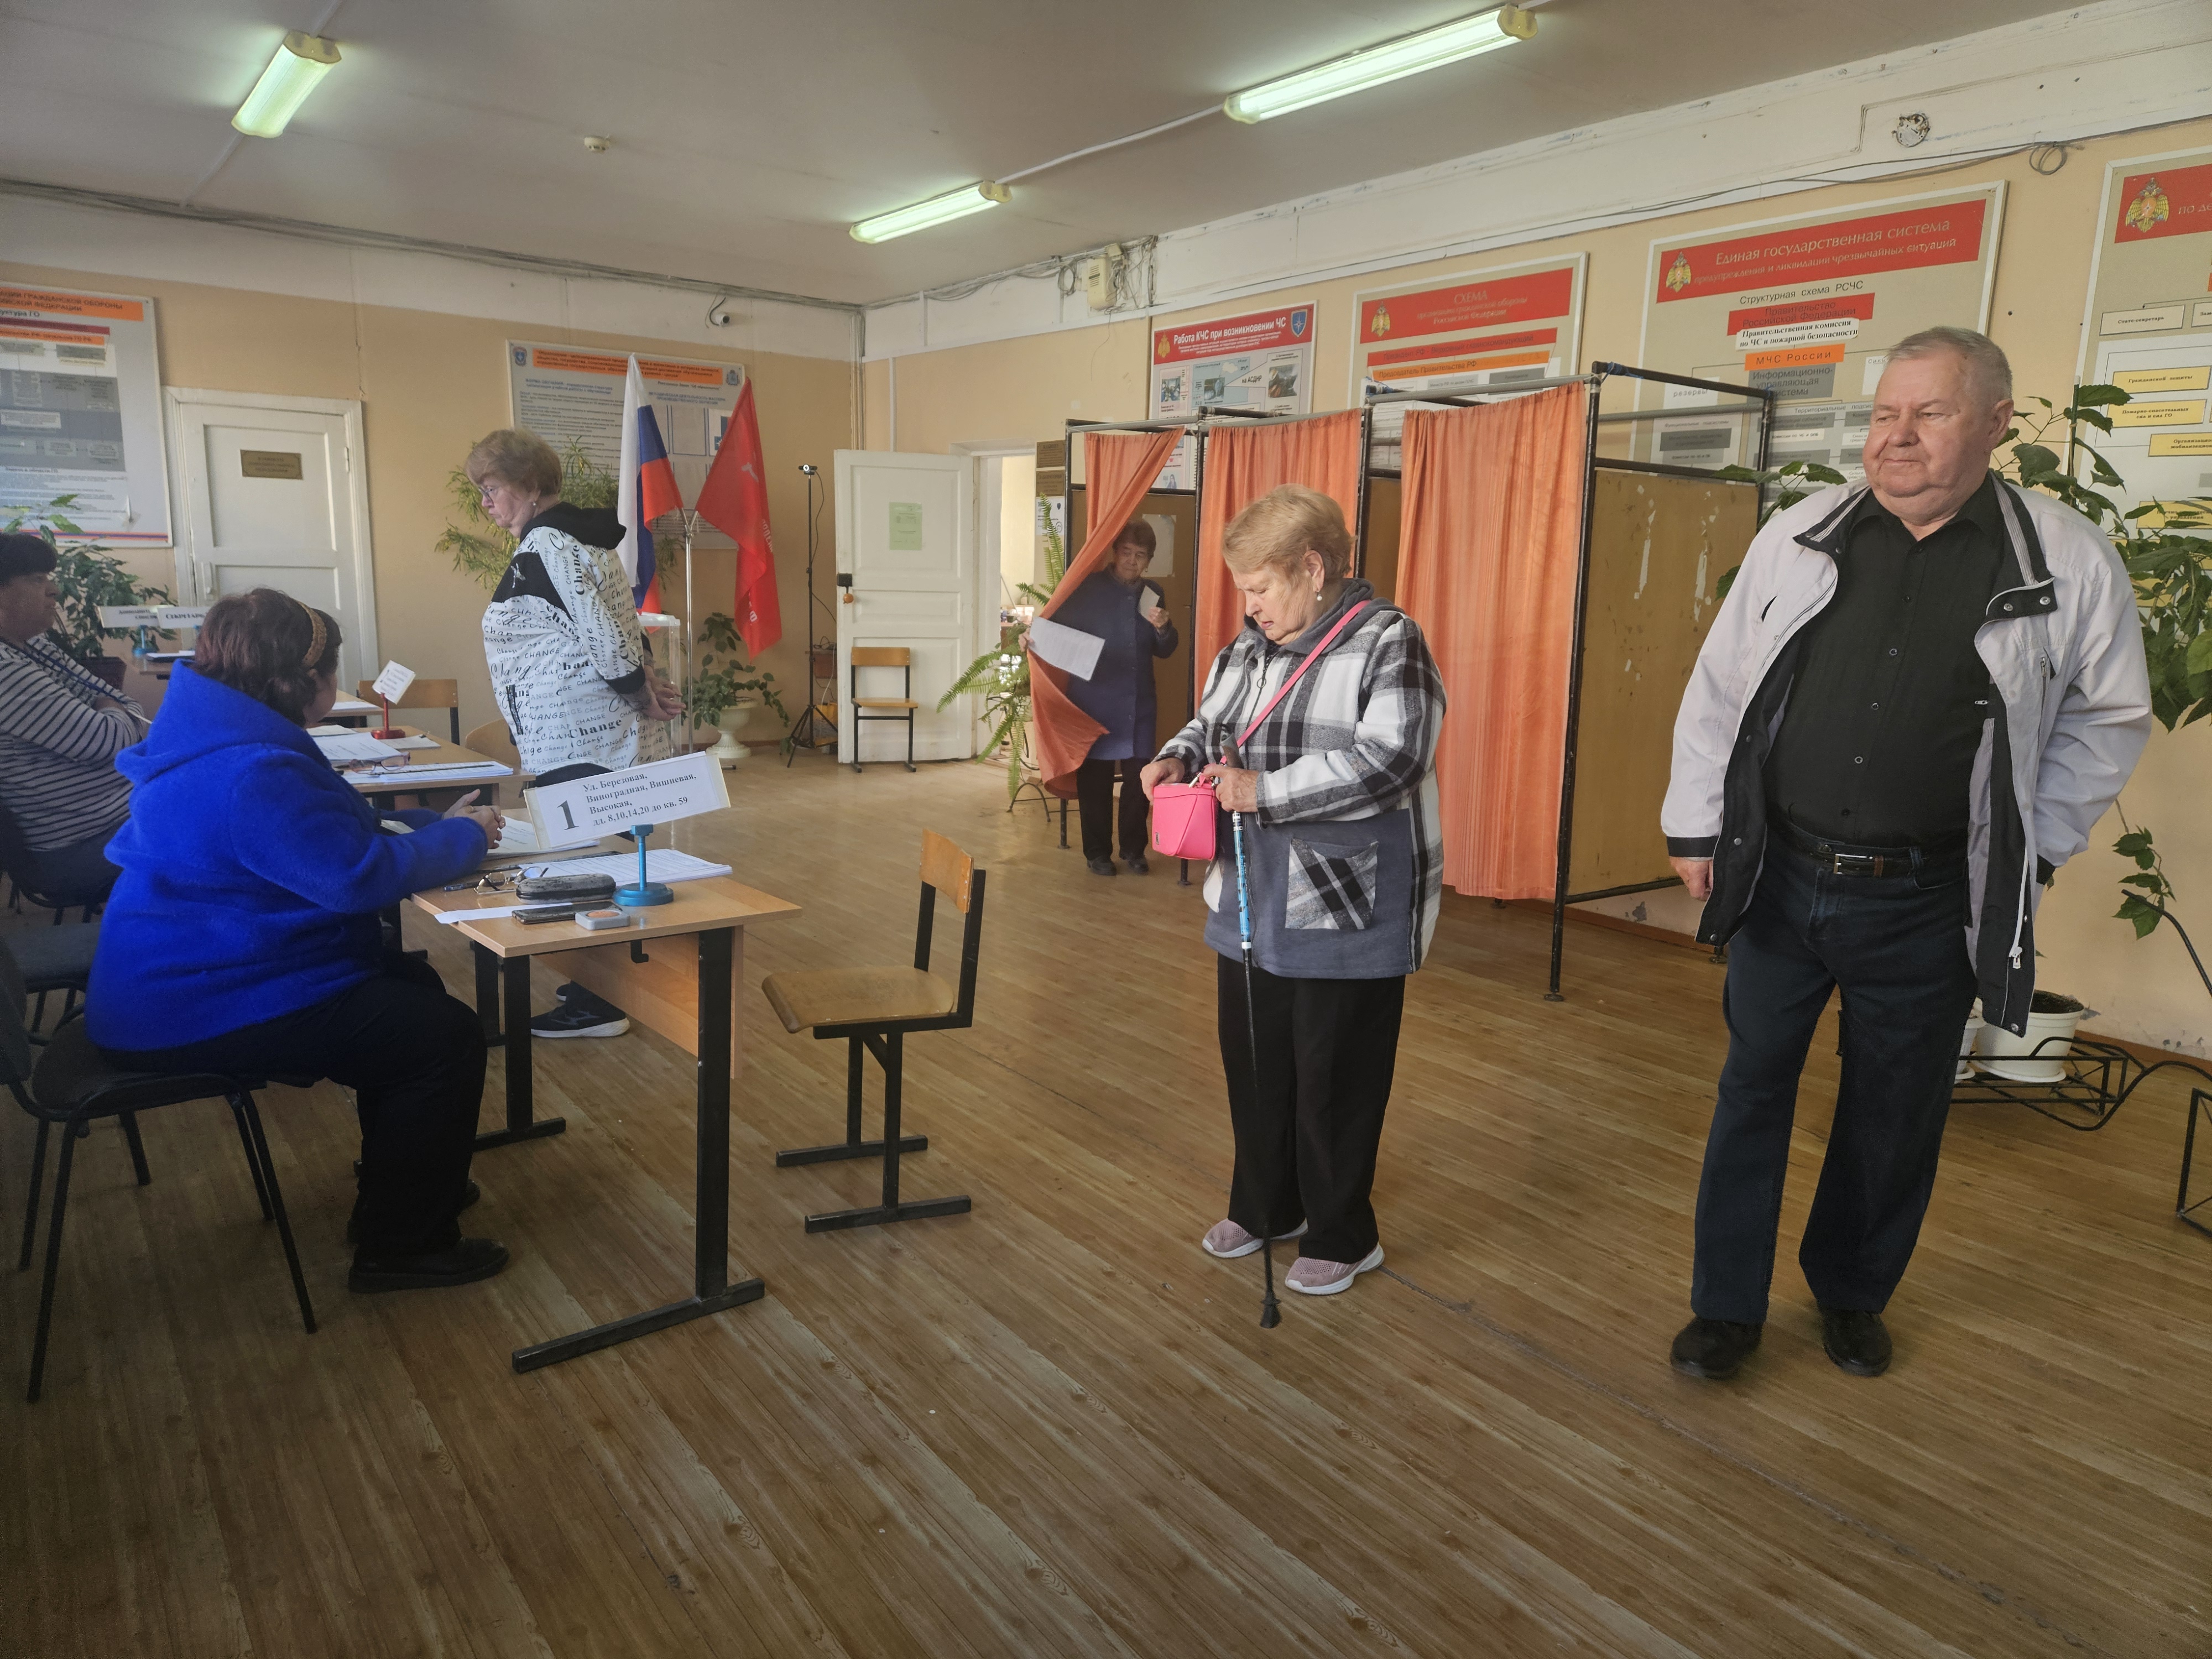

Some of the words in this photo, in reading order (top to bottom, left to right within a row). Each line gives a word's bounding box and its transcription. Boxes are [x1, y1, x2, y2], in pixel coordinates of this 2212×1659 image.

[1716, 248, 1760, 265] Единая
[1764, 231, 1881, 258] государственная
[1887, 220, 1950, 239] система
[1694, 265, 1765, 284] предупреждения
[1776, 255, 1830, 272] ликвидации
[1832, 246, 1903, 264] чрезвычайных
[1906, 238, 1957, 253] ситуаций
[1454, 290, 1488, 304] СХЕМА
[1740, 291, 1796, 305] Структурная
[1802, 286, 1829, 296] схема
[1835, 280, 1863, 292] РСЧС
[1496, 298, 1528, 307] обороны
[1765, 302, 1835, 316] Правительство
[1743, 316, 1797, 327] Российской
[1800, 309, 1856, 321] Федерации
[1174, 333, 1194, 345] Работа
[1196, 330, 1209, 341] КЧС
[1211, 330, 1222, 340] при
[1224, 321, 1274, 336] возникновении
[1276, 317, 1286, 328] ЧС
[1742, 322, 1813, 338] Правительственная
[1815, 320, 1851, 330] комиссия
[1770, 333, 1806, 344] пожарной
[1807, 328, 1858, 340] безопасности
[1384, 351, 1413, 359] Президент
[1431, 344, 1464, 353] Верховный
[1466, 336, 1533, 349] главнокомандующий
[1756, 354, 1781, 365] МЧС
[1787, 352, 1831, 362] России
[1379, 369, 1419, 378] Председатель
[1421, 363, 1465, 373] Правительства
[1467, 360, 1477, 368] РФ
[1753, 367, 1833, 380] Информационно-
[1756, 377, 1819, 389] управляющая
[1673, 389, 1709, 398] резервы
[1773, 388, 1809, 397] истема
[1795, 405, 1846, 414] Территориальные
[562, 556, 571, 585] CHANGE
[572, 545, 585, 595] Change
[558, 672, 586, 680] Change
[576, 713, 606, 725] CHANGE
[570, 719, 622, 738] Change
[577, 736, 603, 747] Change
[595, 738, 623, 750] CHANGE
[583, 784, 598, 792] Ул.
[600, 774, 648, 789] Березовая,
[586, 784, 648, 803] Виноградная,
[649, 774, 697, 789] Вишневая,
[557, 800, 579, 831] 1
[589, 800, 632, 815] Высокая,
[593, 818, 606, 826] дд.
[608, 806, 649, 822] 8,10,14,20
[651, 804, 661, 813] до
[679, 796, 688, 805] 59
